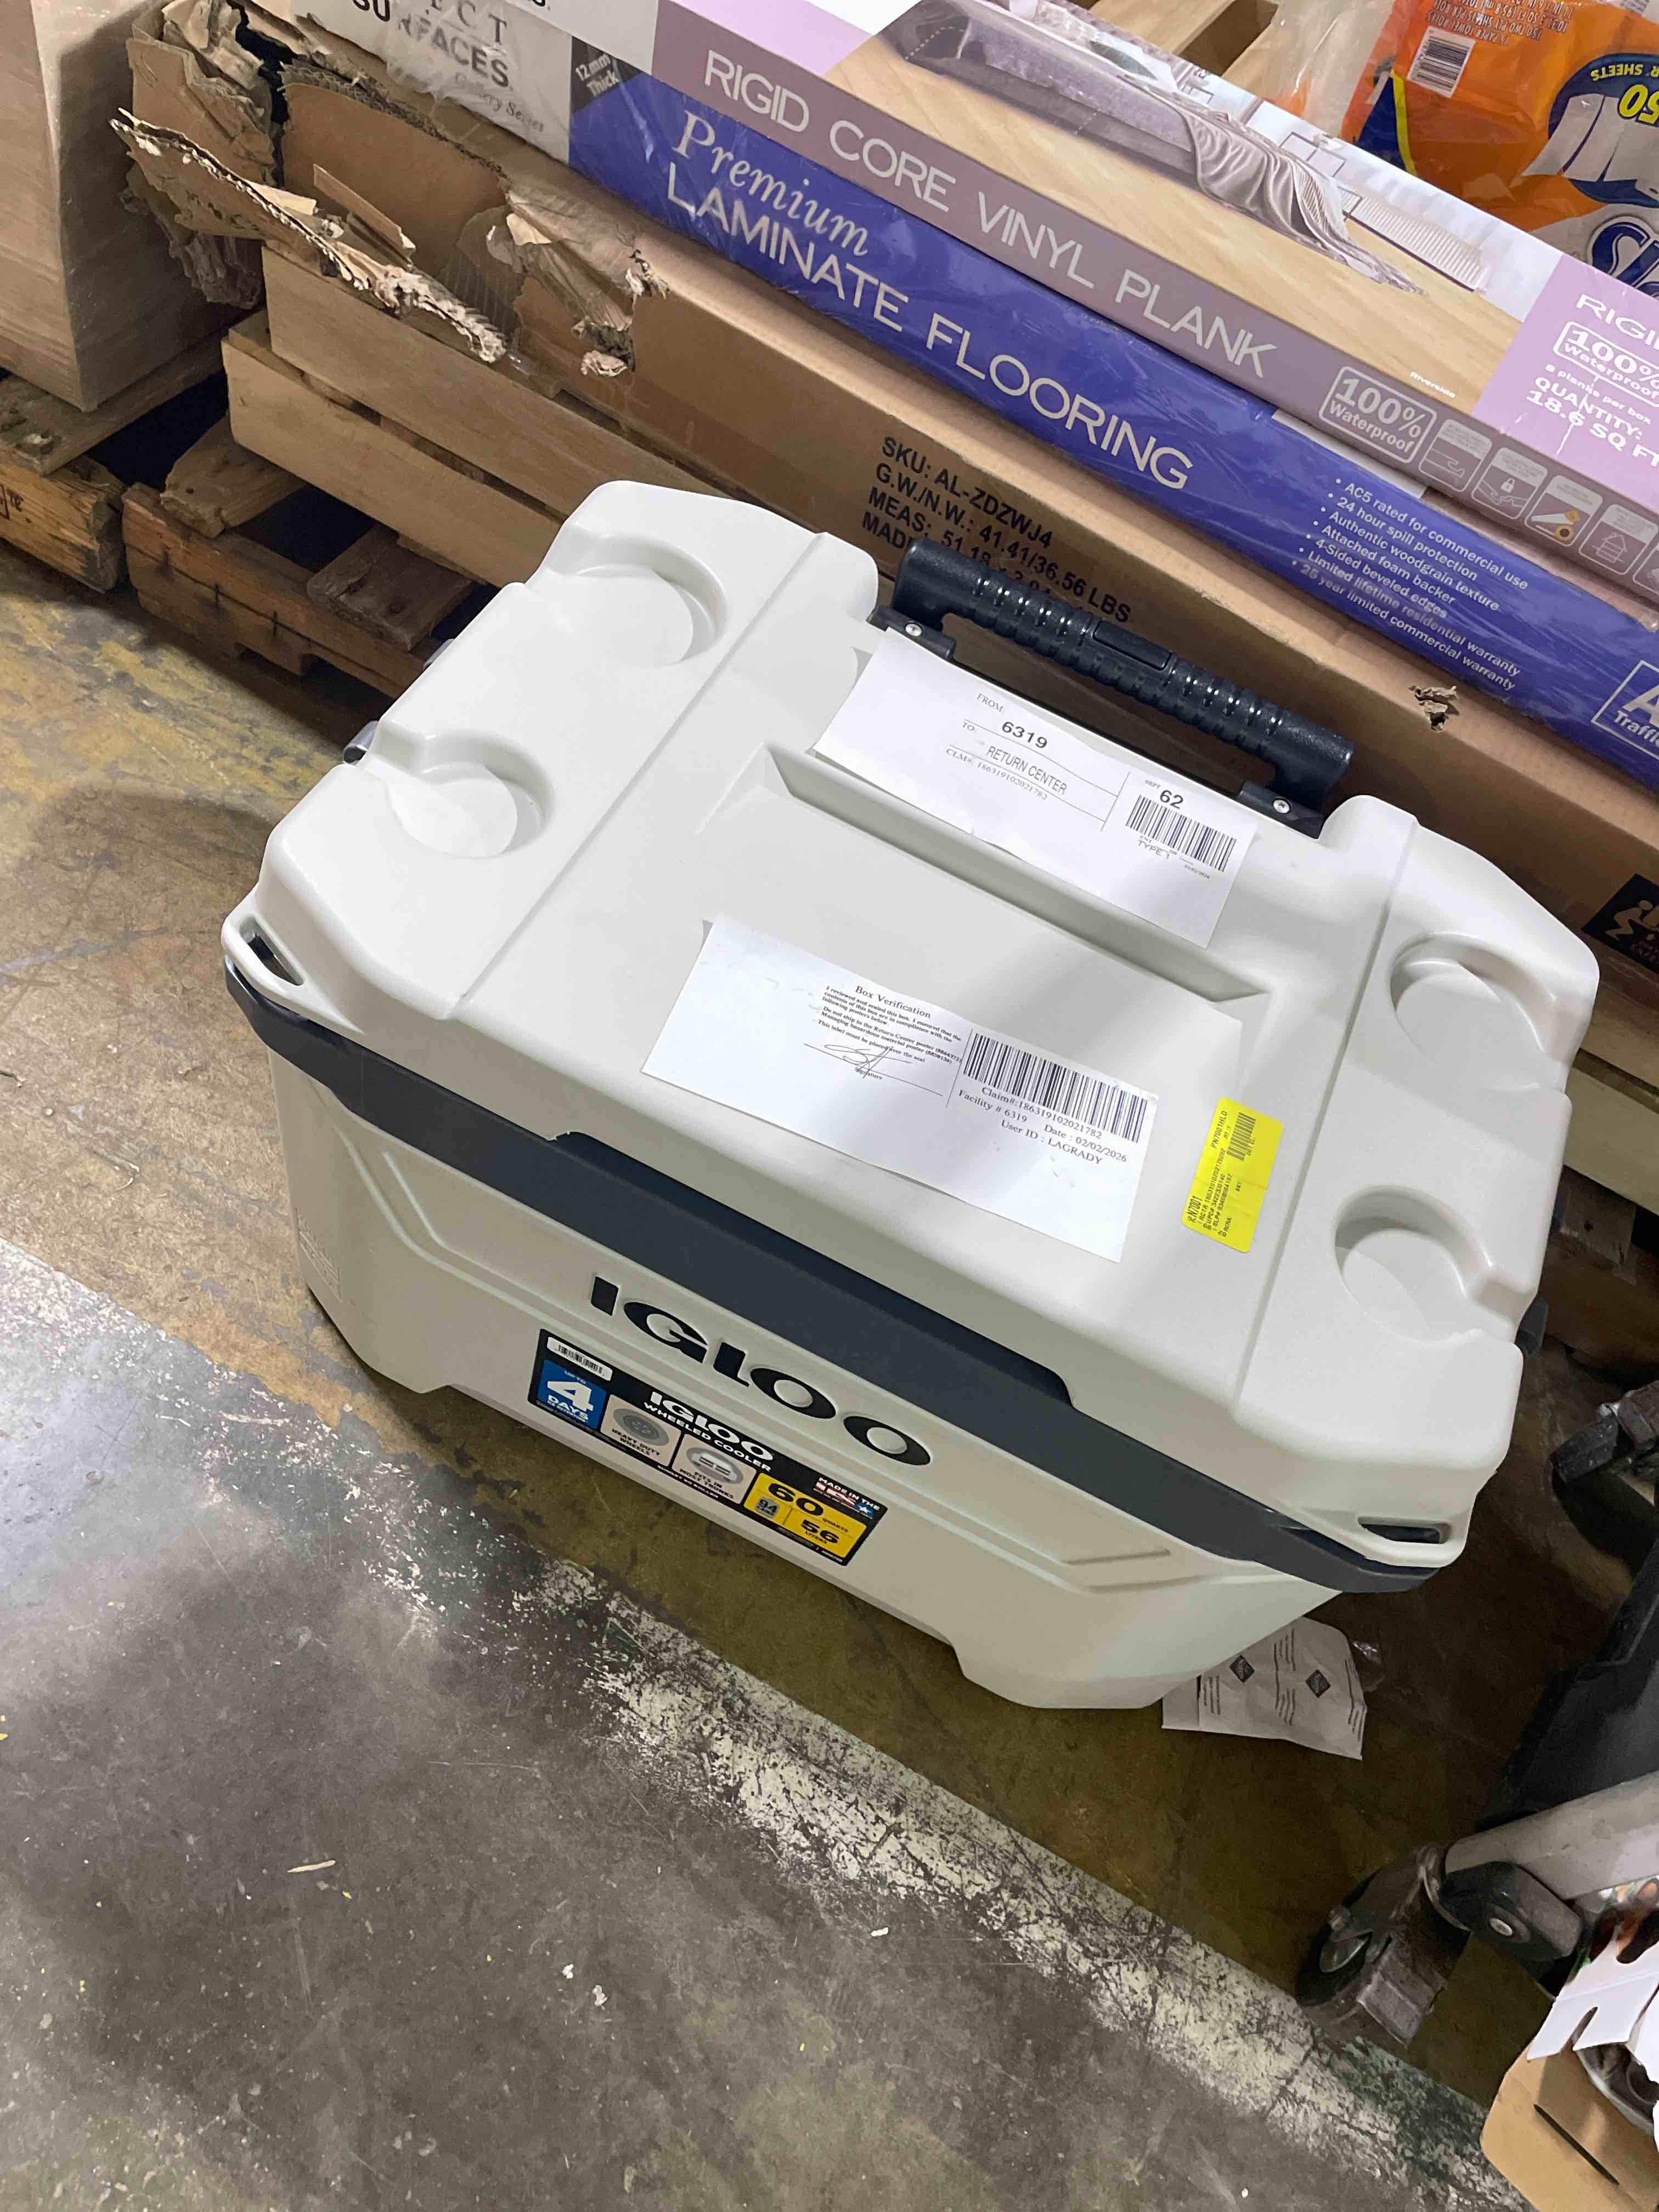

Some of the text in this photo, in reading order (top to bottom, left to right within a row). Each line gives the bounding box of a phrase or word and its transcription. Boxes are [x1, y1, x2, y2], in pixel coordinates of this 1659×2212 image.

[1452, 20, 1474, 36] TOWEL
[1453, 7, 1465, 18] PER
[1467, 9, 1492, 27] SHEETS
[1494, 20, 1506, 31] PLY
[1509, 23, 1524, 35] TWO
[1476, 30, 1498, 43] PAPER
[586, 70, 620, 96] Thick
[1590, 63, 1643, 81] SHEETS
[672, 110, 868, 256] Premium
[704, 49, 1278, 378] RIGID CORE VINYL PLANK
[668, 161, 1194, 489] LAMINATE FLOORING
[1565, 342, 1659, 399] Waterproof
[1335, 378, 1426, 438] 100%
[1535, 377, 1643, 440] QUANTITY:
[1558, 370, 1651, 426] planks per box
[1329, 399, 1415, 453] Waterproof
[1526, 390, 1627, 452] 18.6 SQ
[868, 486, 932, 538] MEAS:
[882, 436, 1053, 550] SKU: AL-ZDZWJ4
[876, 462, 974, 533] G.W./N.W.:
[979, 524, 1087, 597] 41.41/36.56
[1087, 586, 1131, 623] LBS
[1336, 496, 1478, 581] 24 hour spill protection
[1344, 483, 1528, 590] AC5 rated for commercial use
[1315, 539, 1448, 619] 4-Sided beveled edges
[1321, 525, 1456, 604] Attached foam backer
[1329, 511, 1499, 611] Authentic woodgrain texture
[1307, 550, 1521, 677] Limited lifetime residential warranty
[1318, 576, 1516, 691] year limited commercial warranty
[1002, 721, 1048, 749] 6319
[986, 746, 1067, 795] RETURN CENTER
[1159, 789, 1184, 810] 62
[1138, 839, 1163, 856] TYPE
[822, 996, 888, 1025] following posters below.
[823, 991, 848, 1005] contents
[895, 1020, 930, 1034] compliance
[930, 1031, 943, 1039] with
[830, 988, 856, 1001] reviewed
[867, 1003, 887, 1013] sealed
[940, 1029, 952, 1037] that
[855, 985, 931, 1019] Box Verification
[818, 1019, 831, 1028] This
[831, 1025, 845, 1034] label
[845, 1031, 861, 1040] must
[821, 1011, 925, 1053] Managing hazardous material poster
[843, 1014, 856, 1023] ship
[873, 1026, 894, 1037] Return
[894, 1034, 915, 1044] Center
[916, 1041, 934, 1053] poster
[958, 1089, 993, 1111] Facility
[1004, 1109, 1028, 1122] 6319
[1043, 1124, 1066, 1138] Date
[1075, 1136, 1127, 1163] 02/02/2026
[1001, 1119, 1103, 1165] User ID LAGRADY
[591, 1276, 930, 1466] IGLOO
[547, 1380, 594, 1412] 4
[548, 1395, 589, 1420] DAYS
[611, 1428, 661, 1456] HEAVY DUTY
[619, 1437, 650, 1455] WHEELS
[644, 1401, 771, 1472] WHEELED COOLER
[651, 1392, 774, 1462] IGLOO
[679, 1468, 702, 1482] MOST
[694, 1471, 712, 1483] FITS
[819, 1477, 880, 1511] MADE IN THE
[758, 1499, 777, 1513] 94
[768, 1483, 824, 1516] 60
[800, 1519, 839, 1544] 56
[822, 1517, 849, 1533] QUARTS
